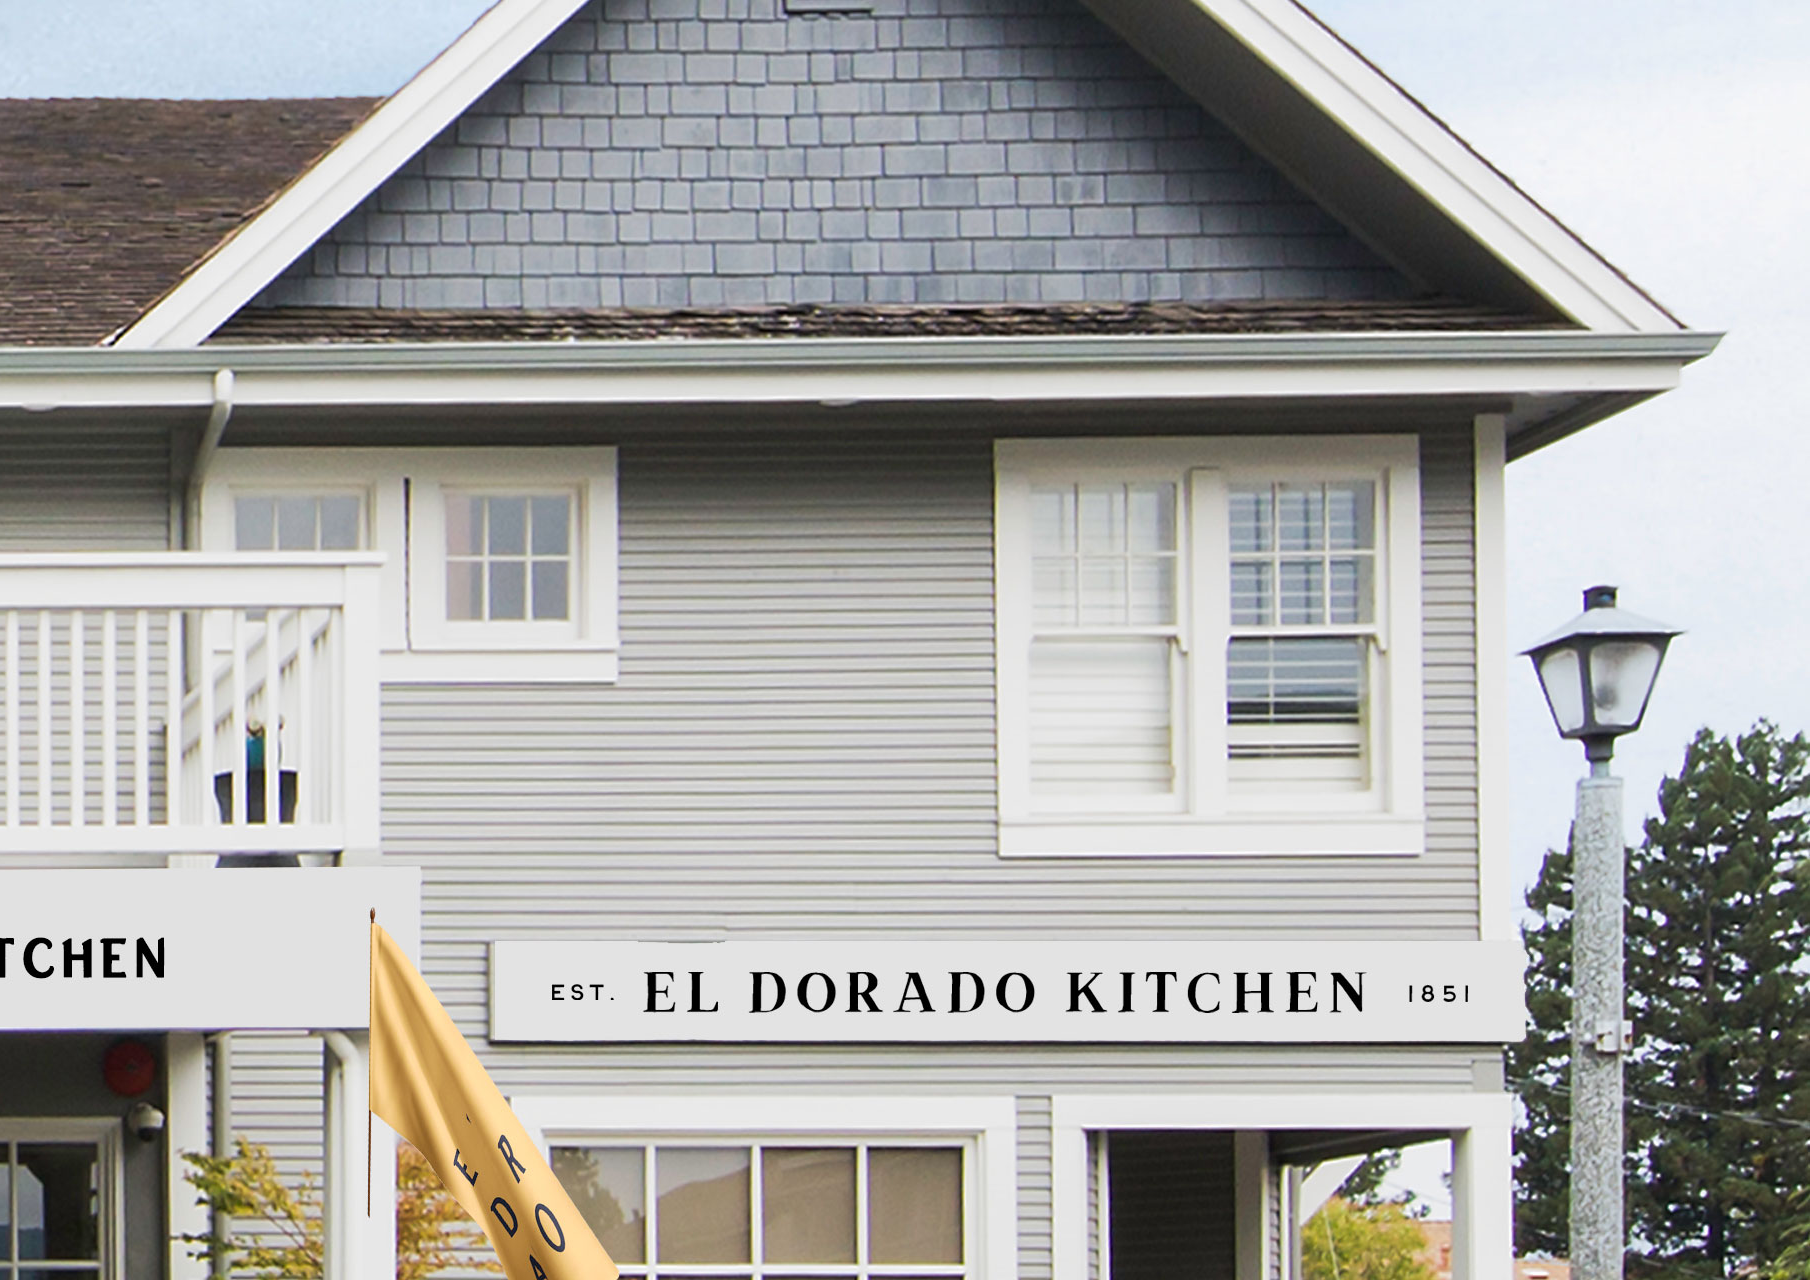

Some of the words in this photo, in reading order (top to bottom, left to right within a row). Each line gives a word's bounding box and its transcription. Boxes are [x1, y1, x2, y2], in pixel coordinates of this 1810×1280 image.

[551, 983, 616, 1002] EST.
[643, 971, 720, 1014] EL
[748, 971, 1036, 1015] DORADO
[1066, 971, 1365, 1015] KITCHEN
[1408, 984, 1470, 1004] 1851
